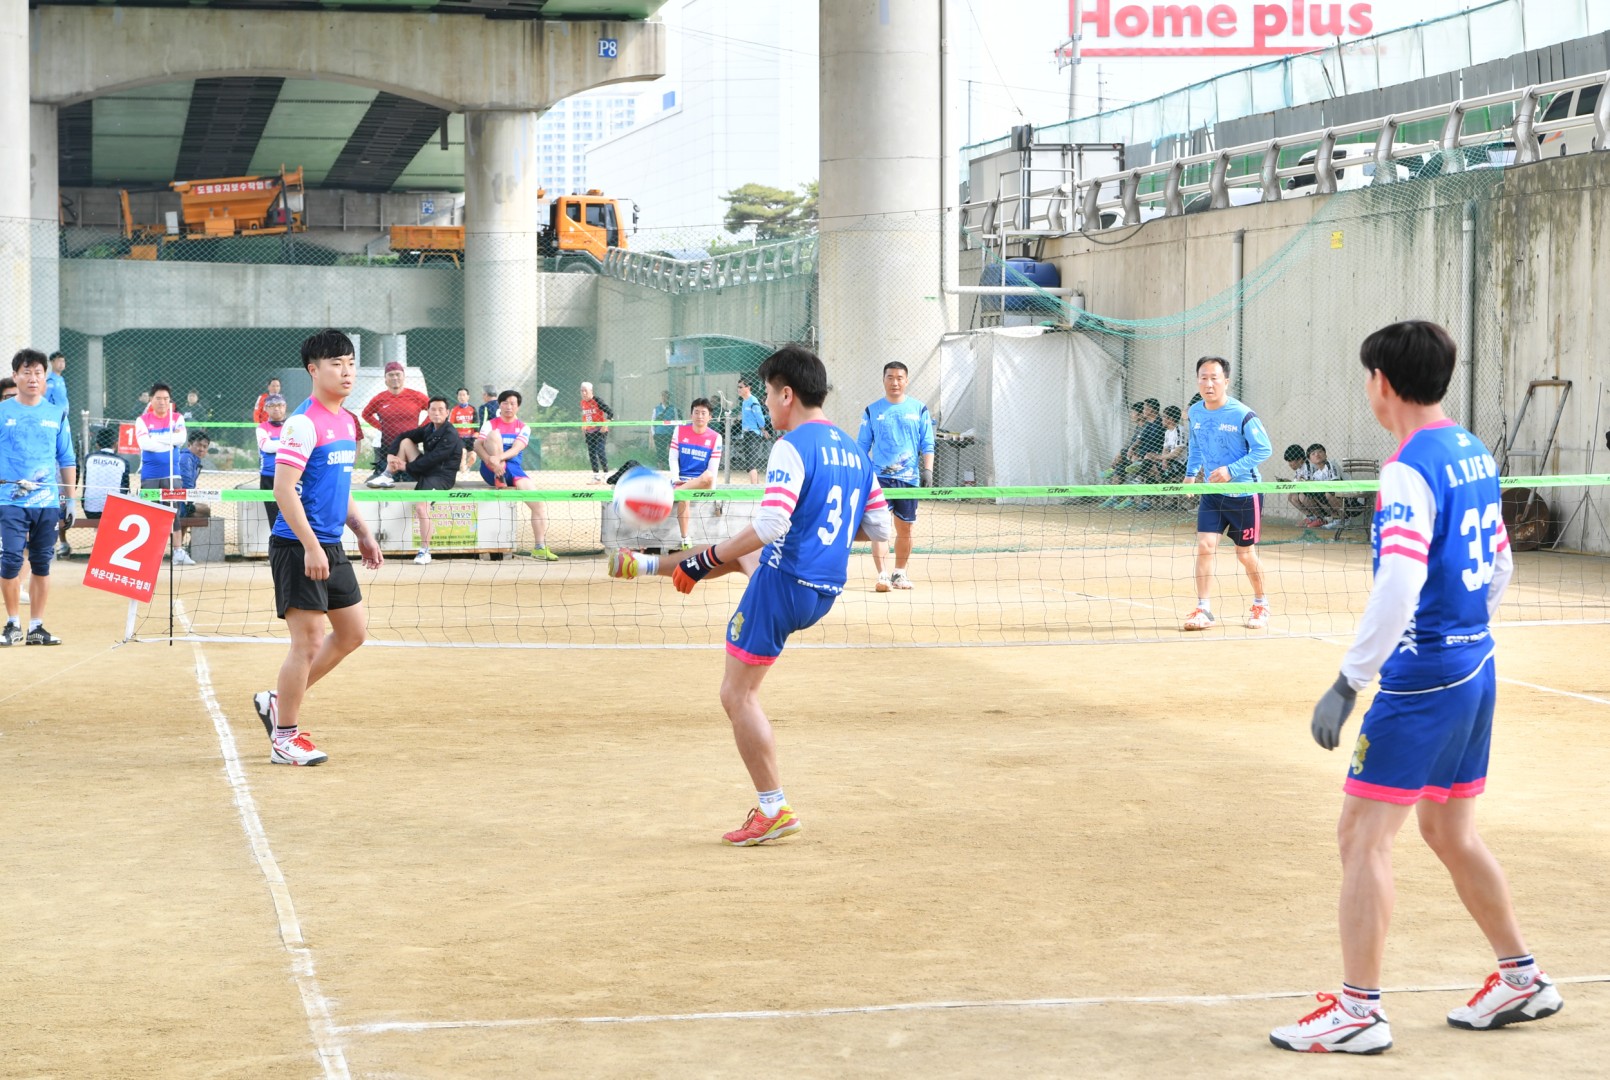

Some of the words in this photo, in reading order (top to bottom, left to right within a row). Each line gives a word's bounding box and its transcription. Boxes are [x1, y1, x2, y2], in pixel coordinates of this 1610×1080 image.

[1069, 0, 1238, 37] Home
[1253, 0, 1374, 48] plus
[598, 40, 617, 57] P8
[125, 427, 135, 446] 1
[93, 458, 119, 467] BUSAN
[449, 491, 473, 499] star
[571, 491, 595, 499] star
[692, 490, 716, 498] star
[817, 485, 860, 549] 31
[1242, 527, 1255, 540] 21
[109, 514, 151, 572] 2
[1460, 502, 1499, 592] 33
[90, 567, 152, 592] 해운대구족구협회
